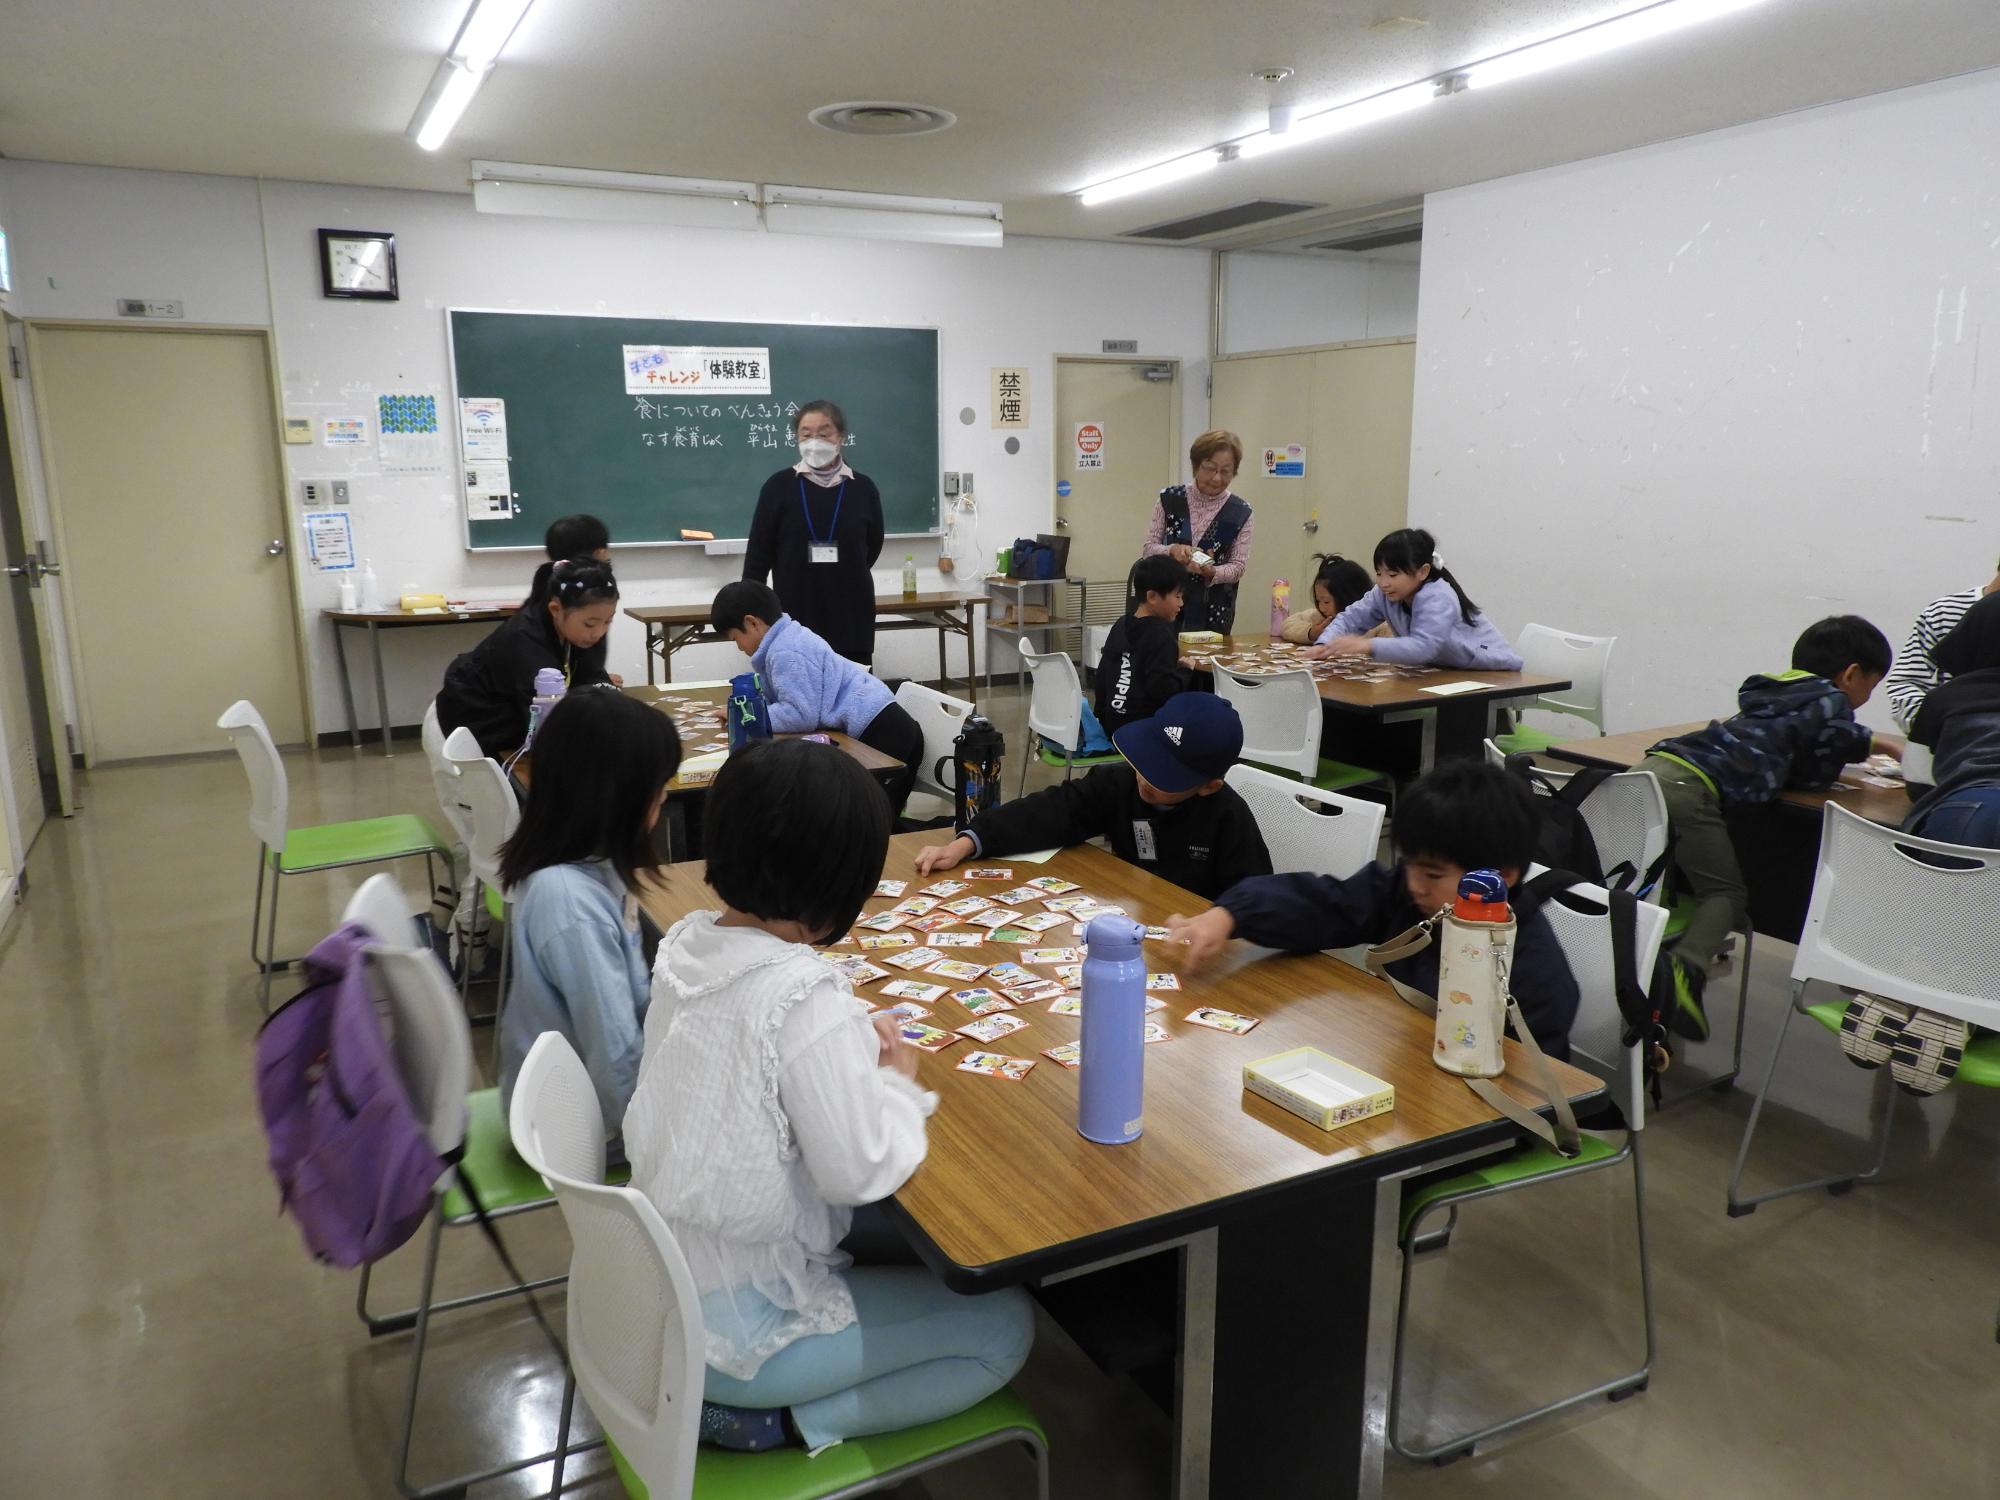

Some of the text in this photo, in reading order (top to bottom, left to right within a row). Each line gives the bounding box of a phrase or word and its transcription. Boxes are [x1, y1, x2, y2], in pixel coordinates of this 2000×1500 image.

[630, 353, 663, 373] 子ども
[703, 359, 766, 380] 「体験教室」
[646, 371, 700, 384] チャレンジ
[999, 371, 1021, 423] 禁煙
[466, 426, 482, 434] Free
[641, 432, 723, 448] なす食育じゅく
[1081, 442, 1099, 450] Only
[1079, 460, 1102, 468] 立入禁止
[1164, 726, 1183, 746] adidas
